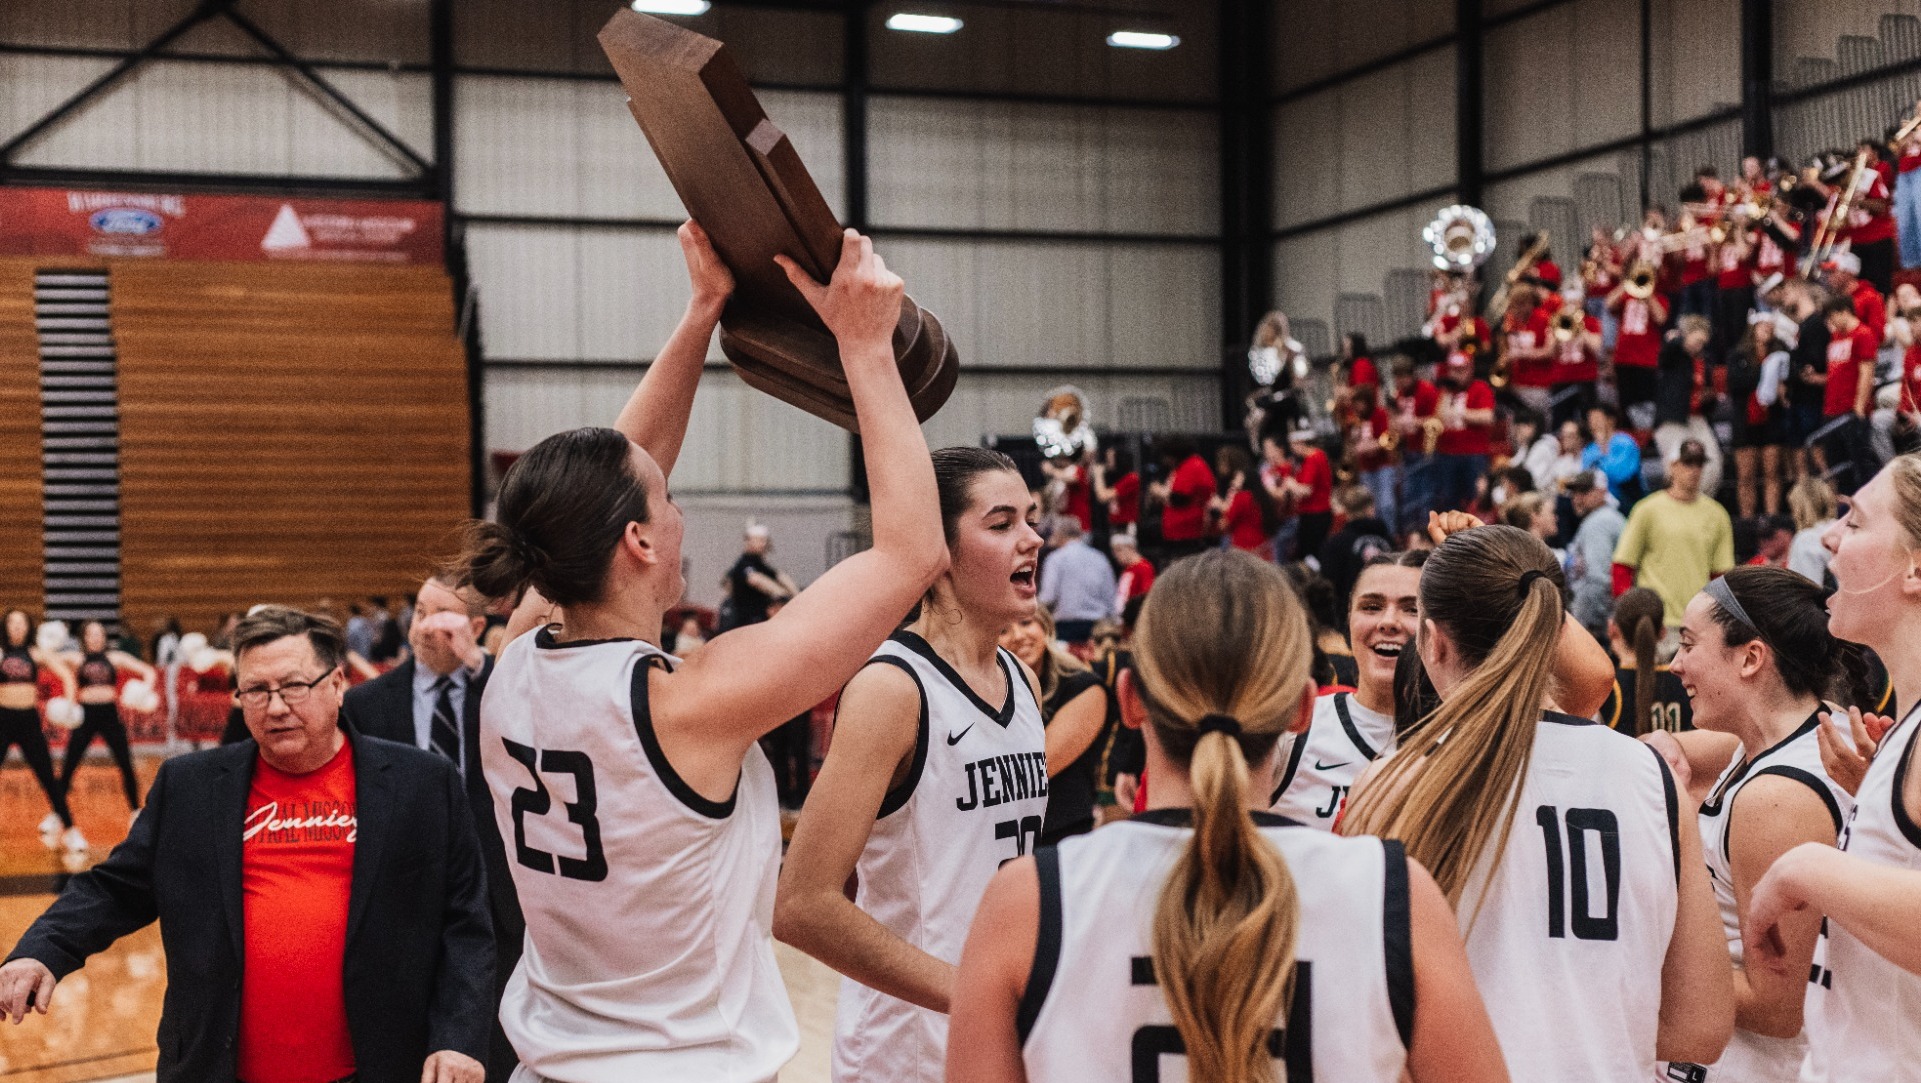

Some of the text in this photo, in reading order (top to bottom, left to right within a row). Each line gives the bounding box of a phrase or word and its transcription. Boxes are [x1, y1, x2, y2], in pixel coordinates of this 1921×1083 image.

[501, 736, 609, 883] 23
[955, 751, 1048, 812] JENNIE
[1315, 785, 1351, 819] J
[1535, 804, 1621, 941] 10
